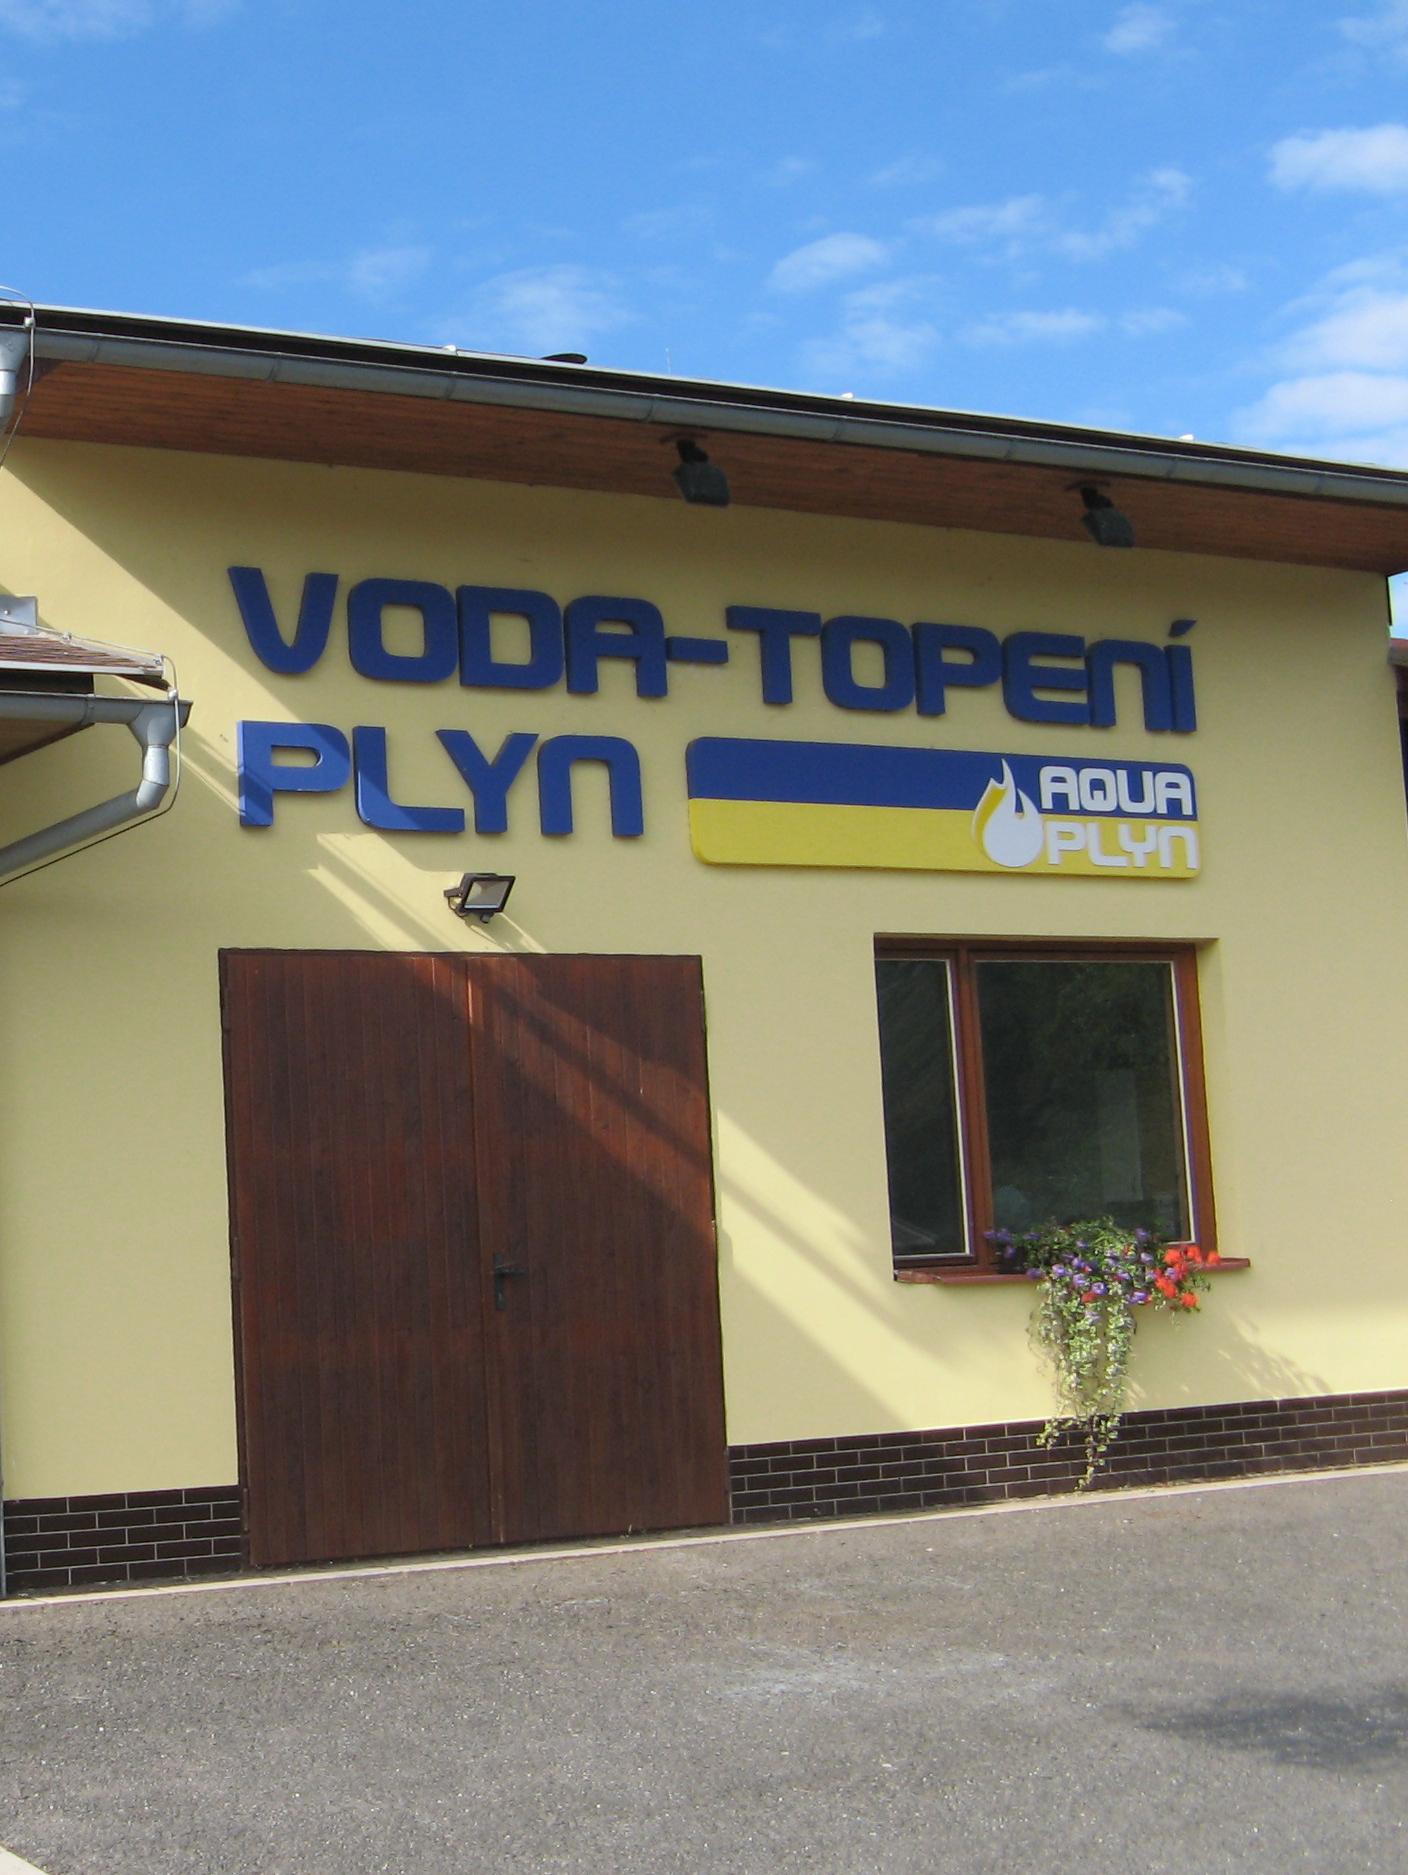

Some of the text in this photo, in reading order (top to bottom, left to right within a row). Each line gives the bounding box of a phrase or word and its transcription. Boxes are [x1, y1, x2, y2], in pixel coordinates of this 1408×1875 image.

[236, 719, 645, 837] PLYN
[1038, 765, 1194, 816] AQUA
[1043, 823, 1199, 870] PLYN
